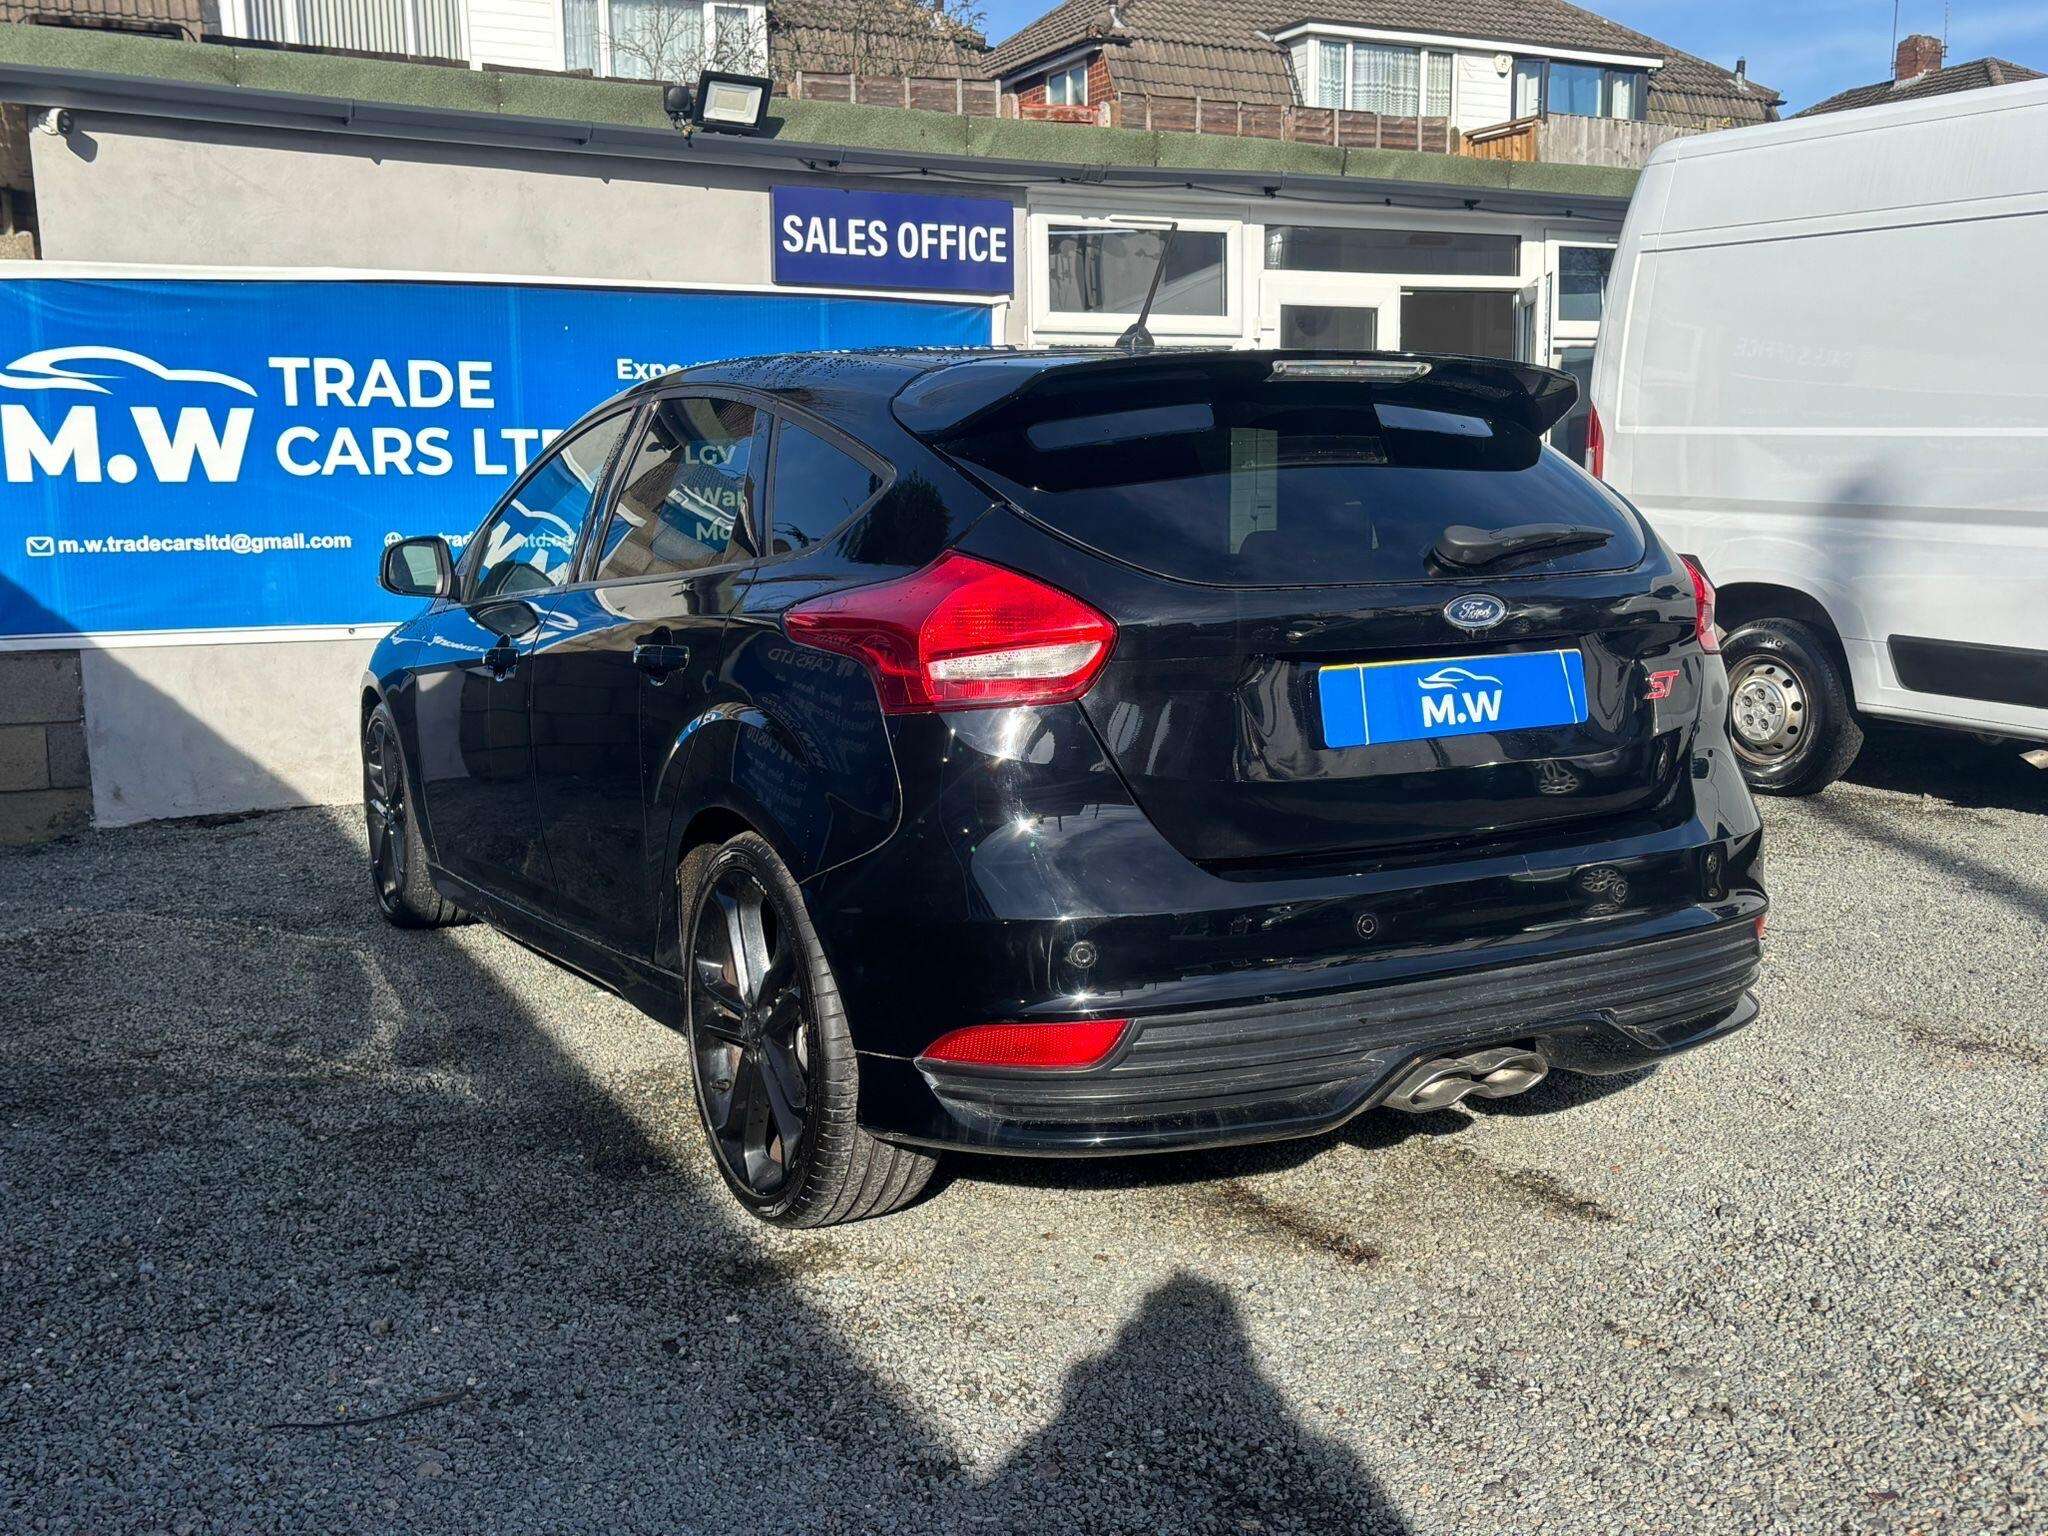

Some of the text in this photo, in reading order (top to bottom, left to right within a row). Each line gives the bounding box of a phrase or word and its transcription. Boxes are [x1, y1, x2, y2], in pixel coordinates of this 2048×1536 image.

[783, 214, 1007, 263] SALES OFFICE
[268, 357, 495, 409] TRADE
[1, 404, 254, 483] M.W
[276, 427, 453, 476] CARS
[58, 533, 352, 553] m.w.tradecarsltd@gmail.com
[1458, 600, 1493, 620] Ford
[1646, 669, 1680, 699] ST
[1420, 689, 1503, 728] M.W
